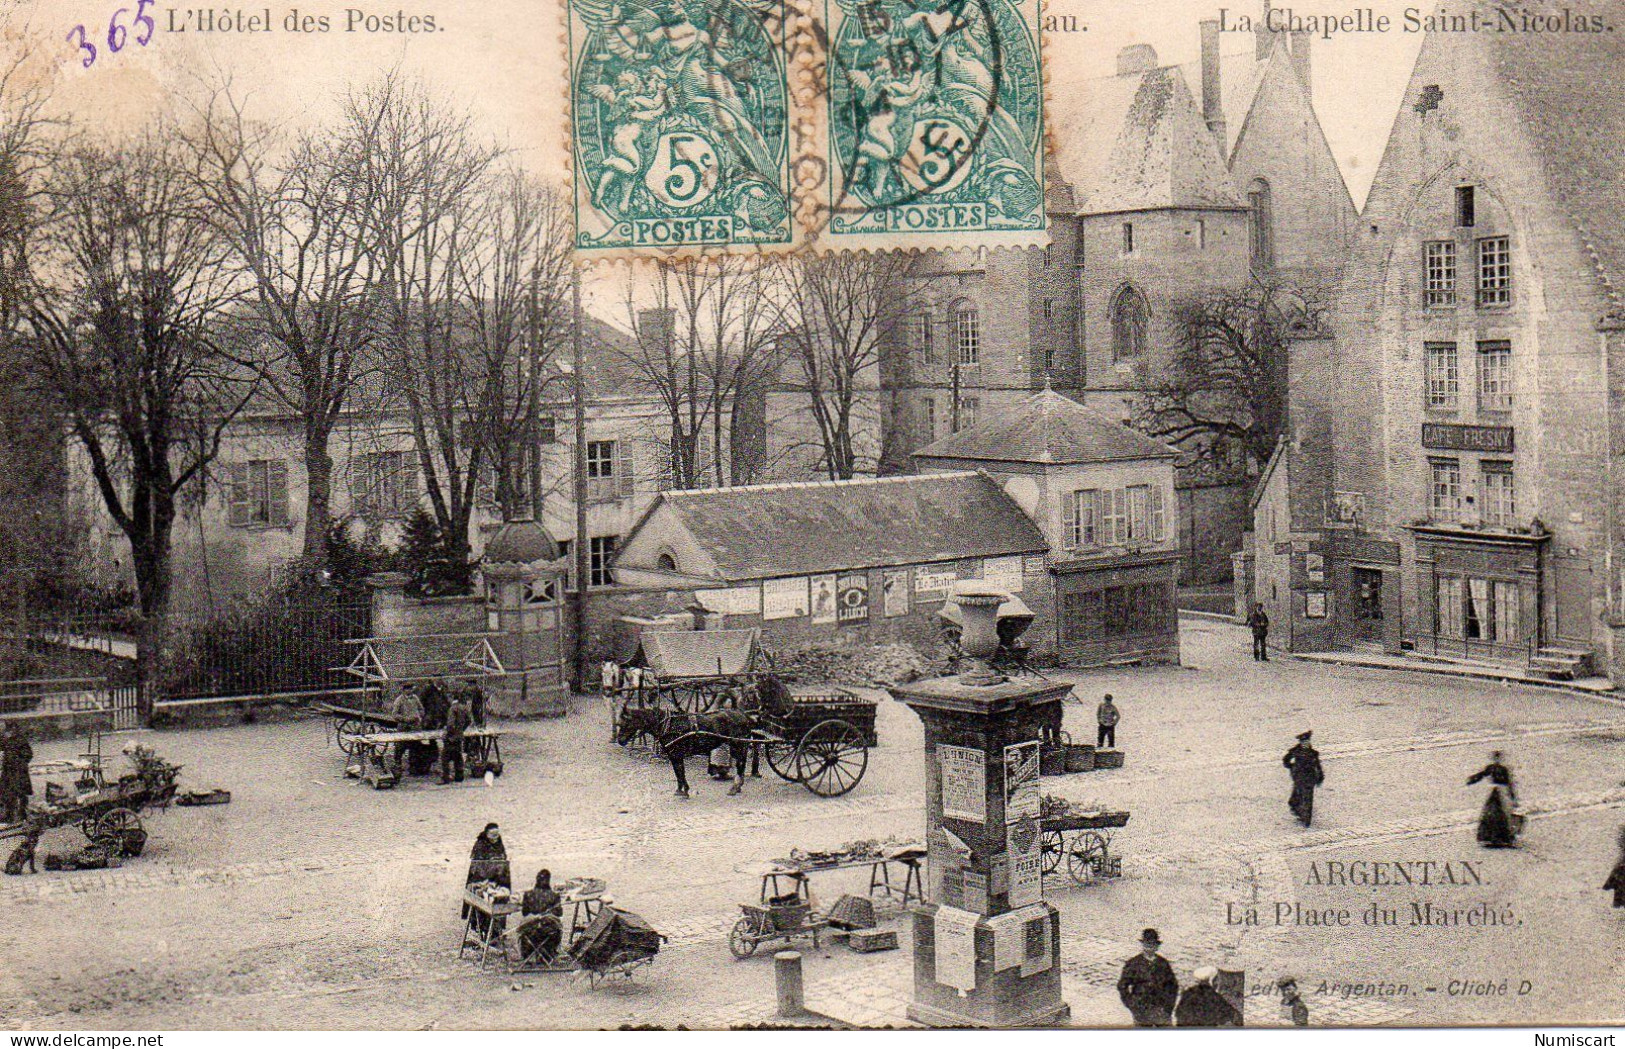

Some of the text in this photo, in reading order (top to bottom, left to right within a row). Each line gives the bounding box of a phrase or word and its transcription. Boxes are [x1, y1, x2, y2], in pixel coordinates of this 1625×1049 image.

[65, 0, 155, 68] 365
[888, 206, 984, 229] POSTES
[635, 219, 730, 243] POSTES
